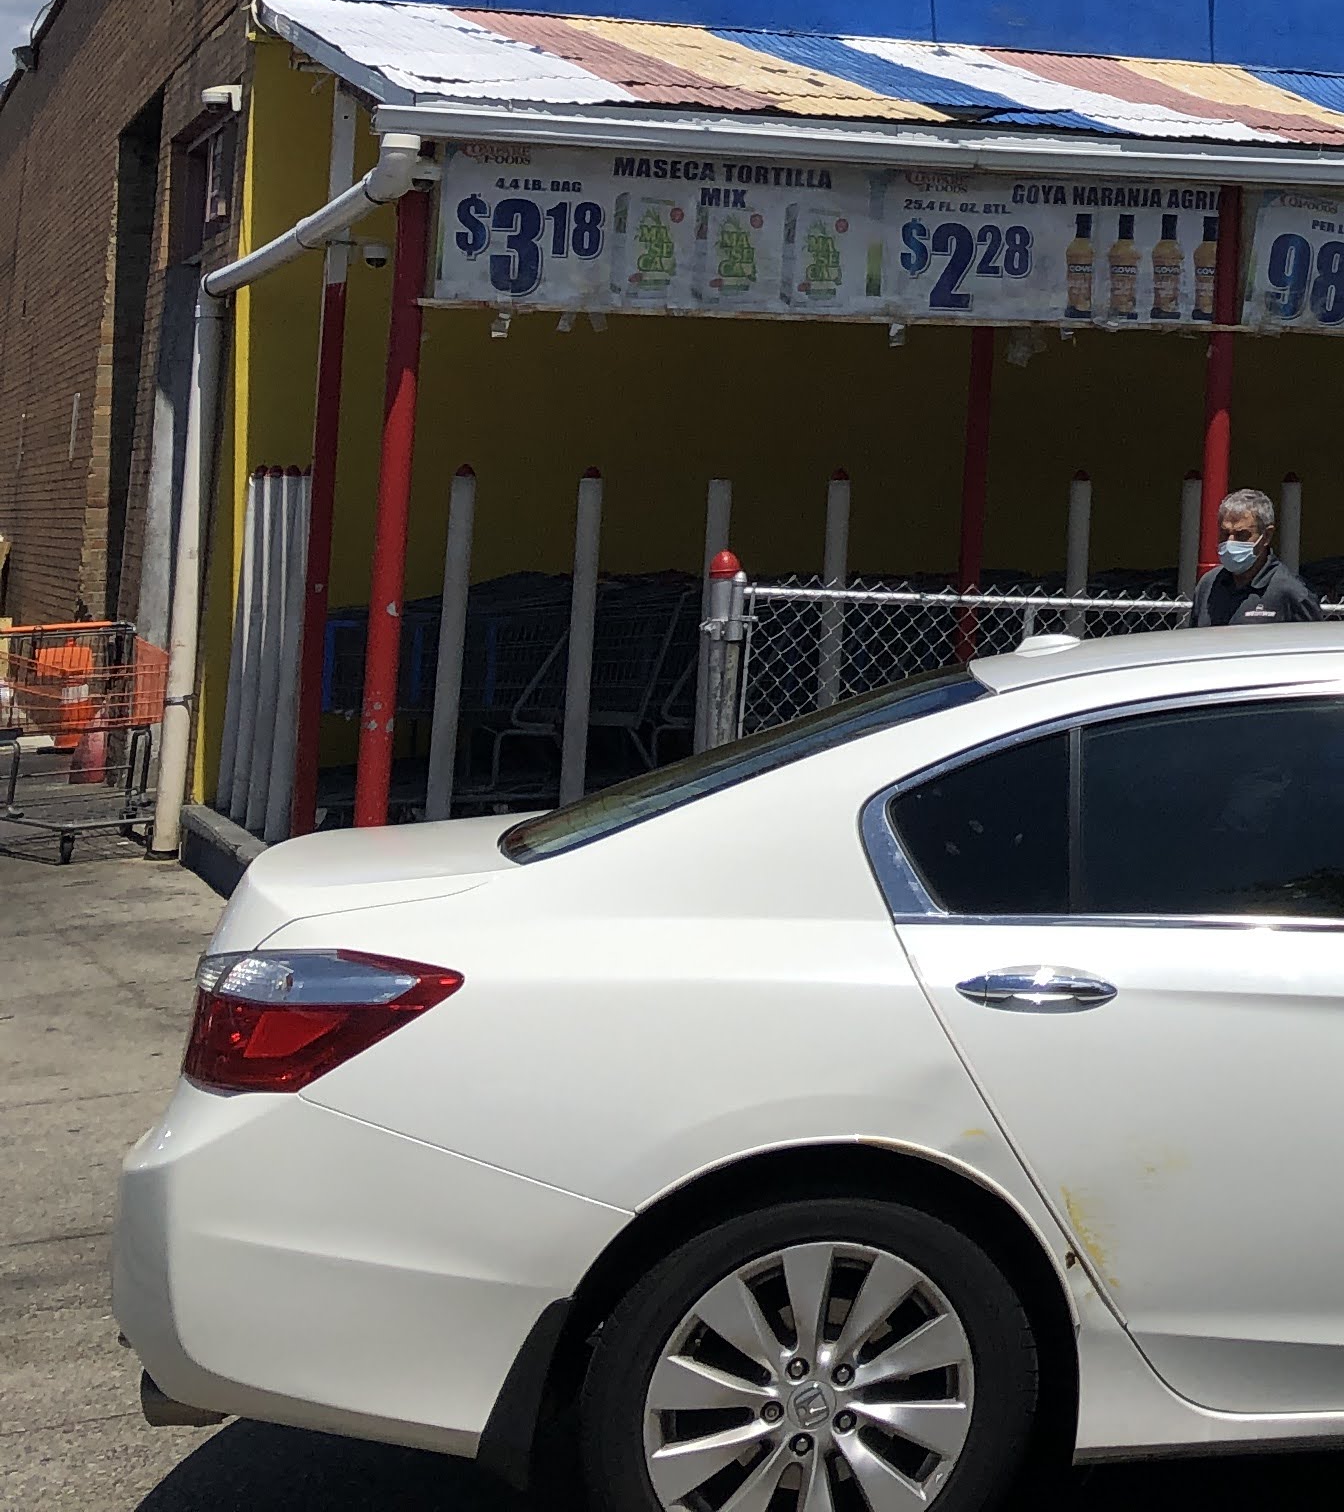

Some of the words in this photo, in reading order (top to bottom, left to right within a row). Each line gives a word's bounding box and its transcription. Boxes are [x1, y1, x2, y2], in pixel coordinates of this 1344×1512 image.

[613, 156, 716, 181] MASECA
[723, 163, 832, 189] TORTILLA
[550, 181, 582, 193] BAG
[700, 187, 747, 208] MIX
[1011, 184, 1067, 206] GOYA
[1072, 185, 1162, 208] NARANJA
[1312, 220, 1335, 233] PER
[901, 218, 1033, 310] $228
